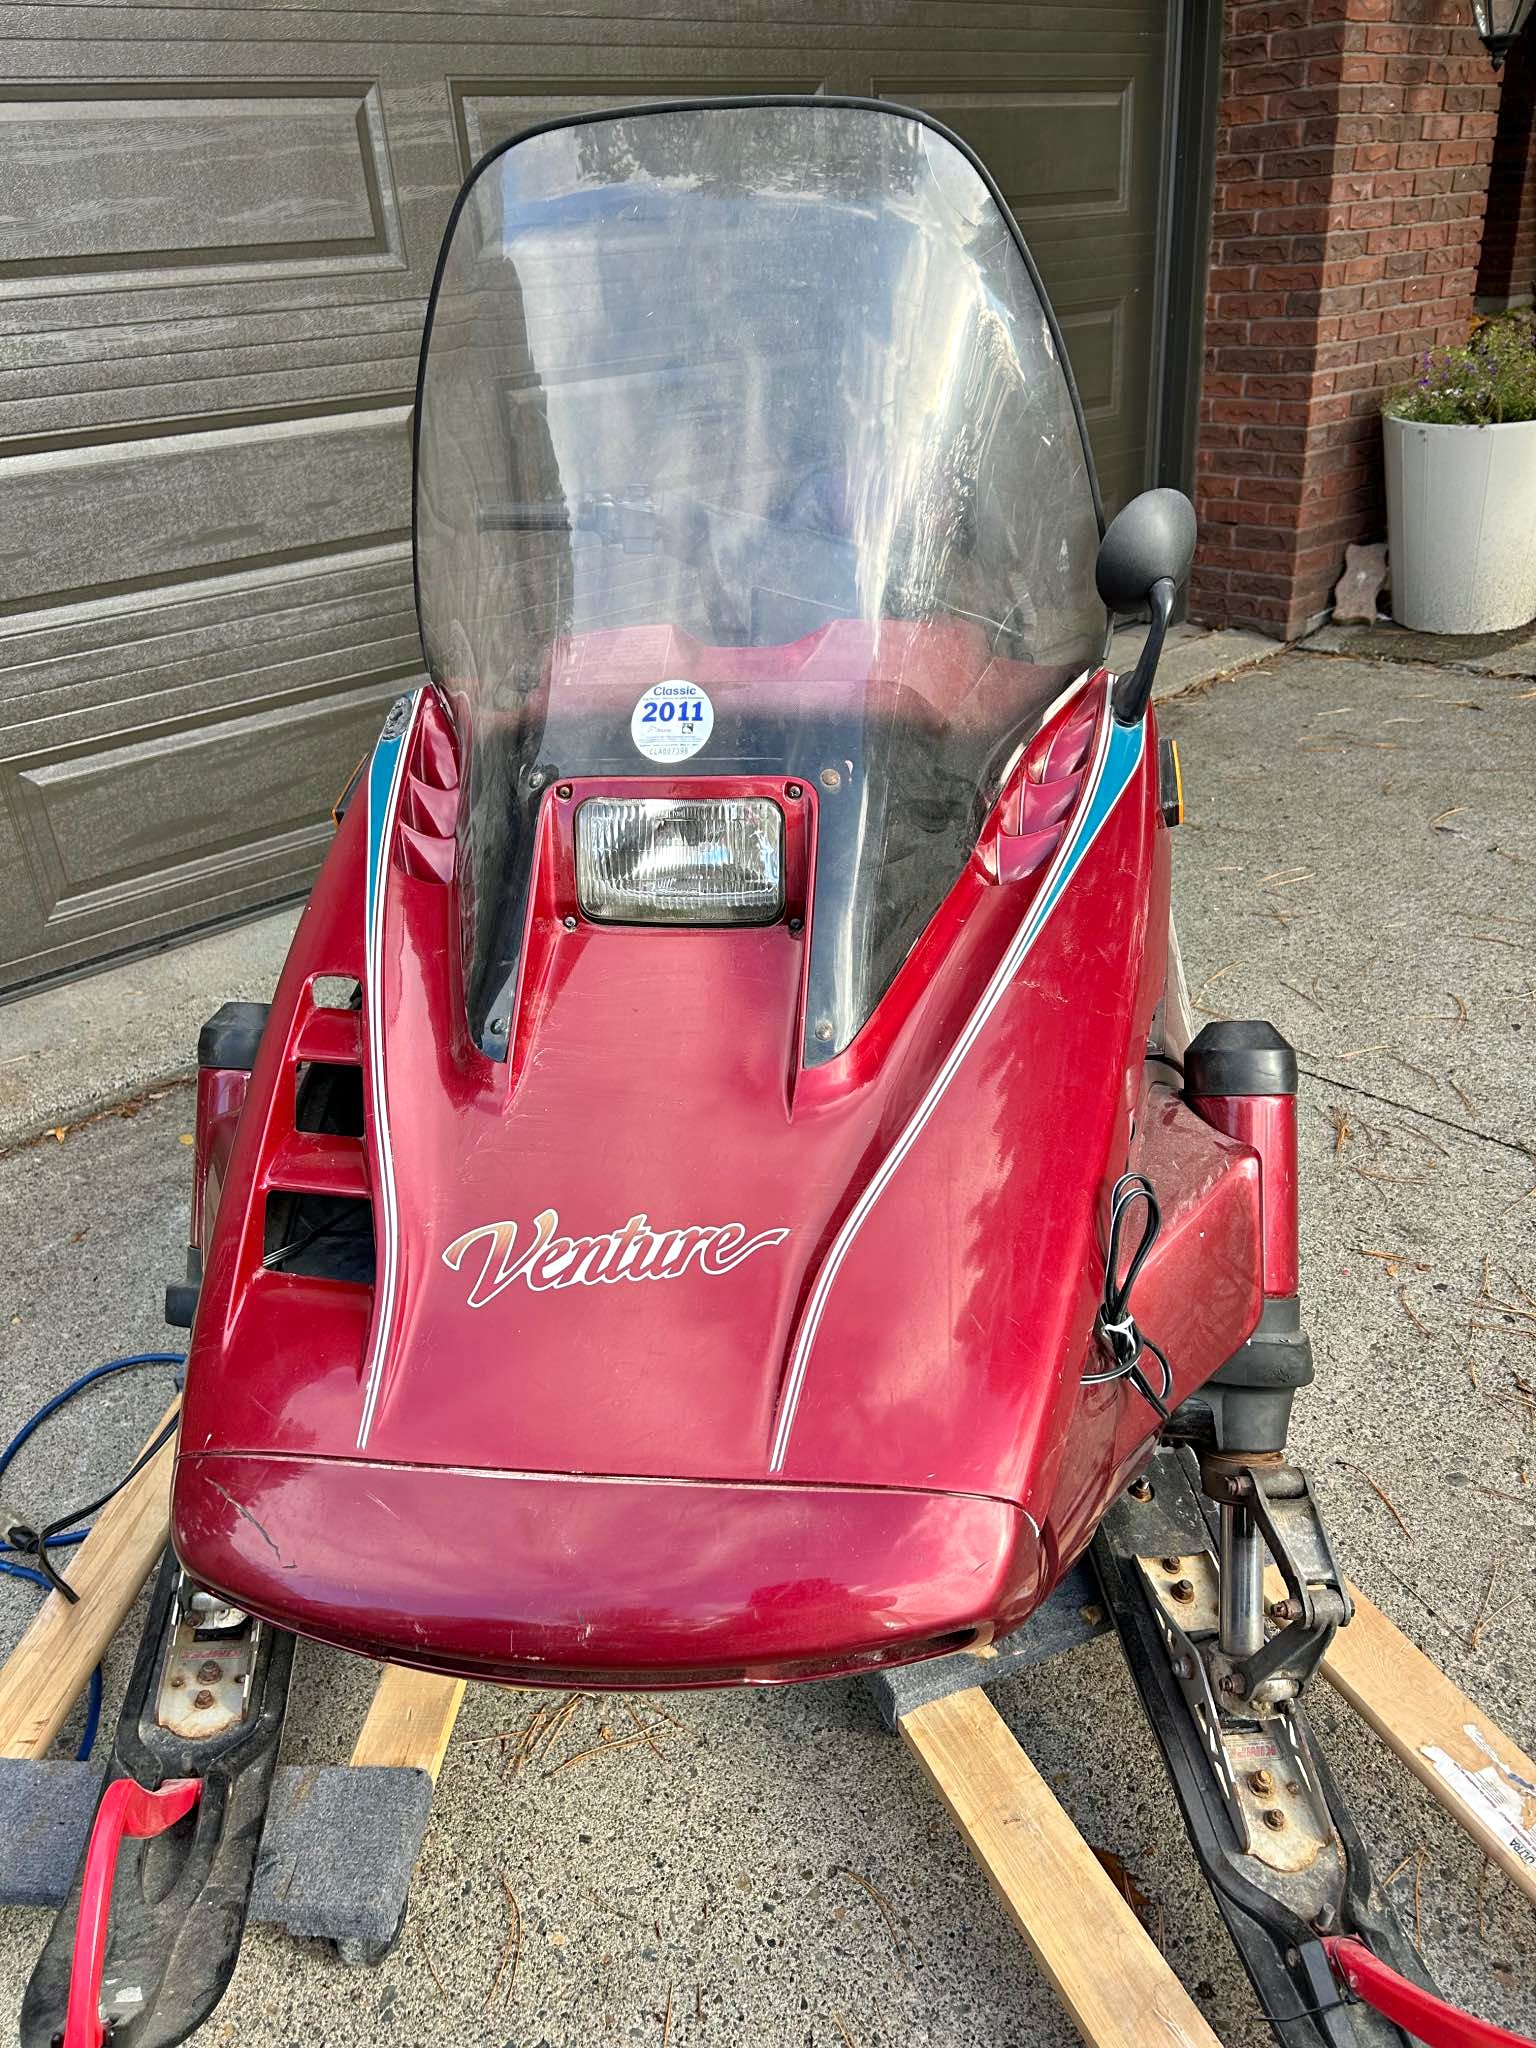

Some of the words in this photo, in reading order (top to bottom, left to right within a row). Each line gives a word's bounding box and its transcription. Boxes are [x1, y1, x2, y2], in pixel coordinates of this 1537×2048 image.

[653, 685, 697, 697] Classic
[642, 701, 704, 723] 2011
[441, 1208, 792, 1309] Venture
[1509, 1838, 1536, 1864] ULTRA
